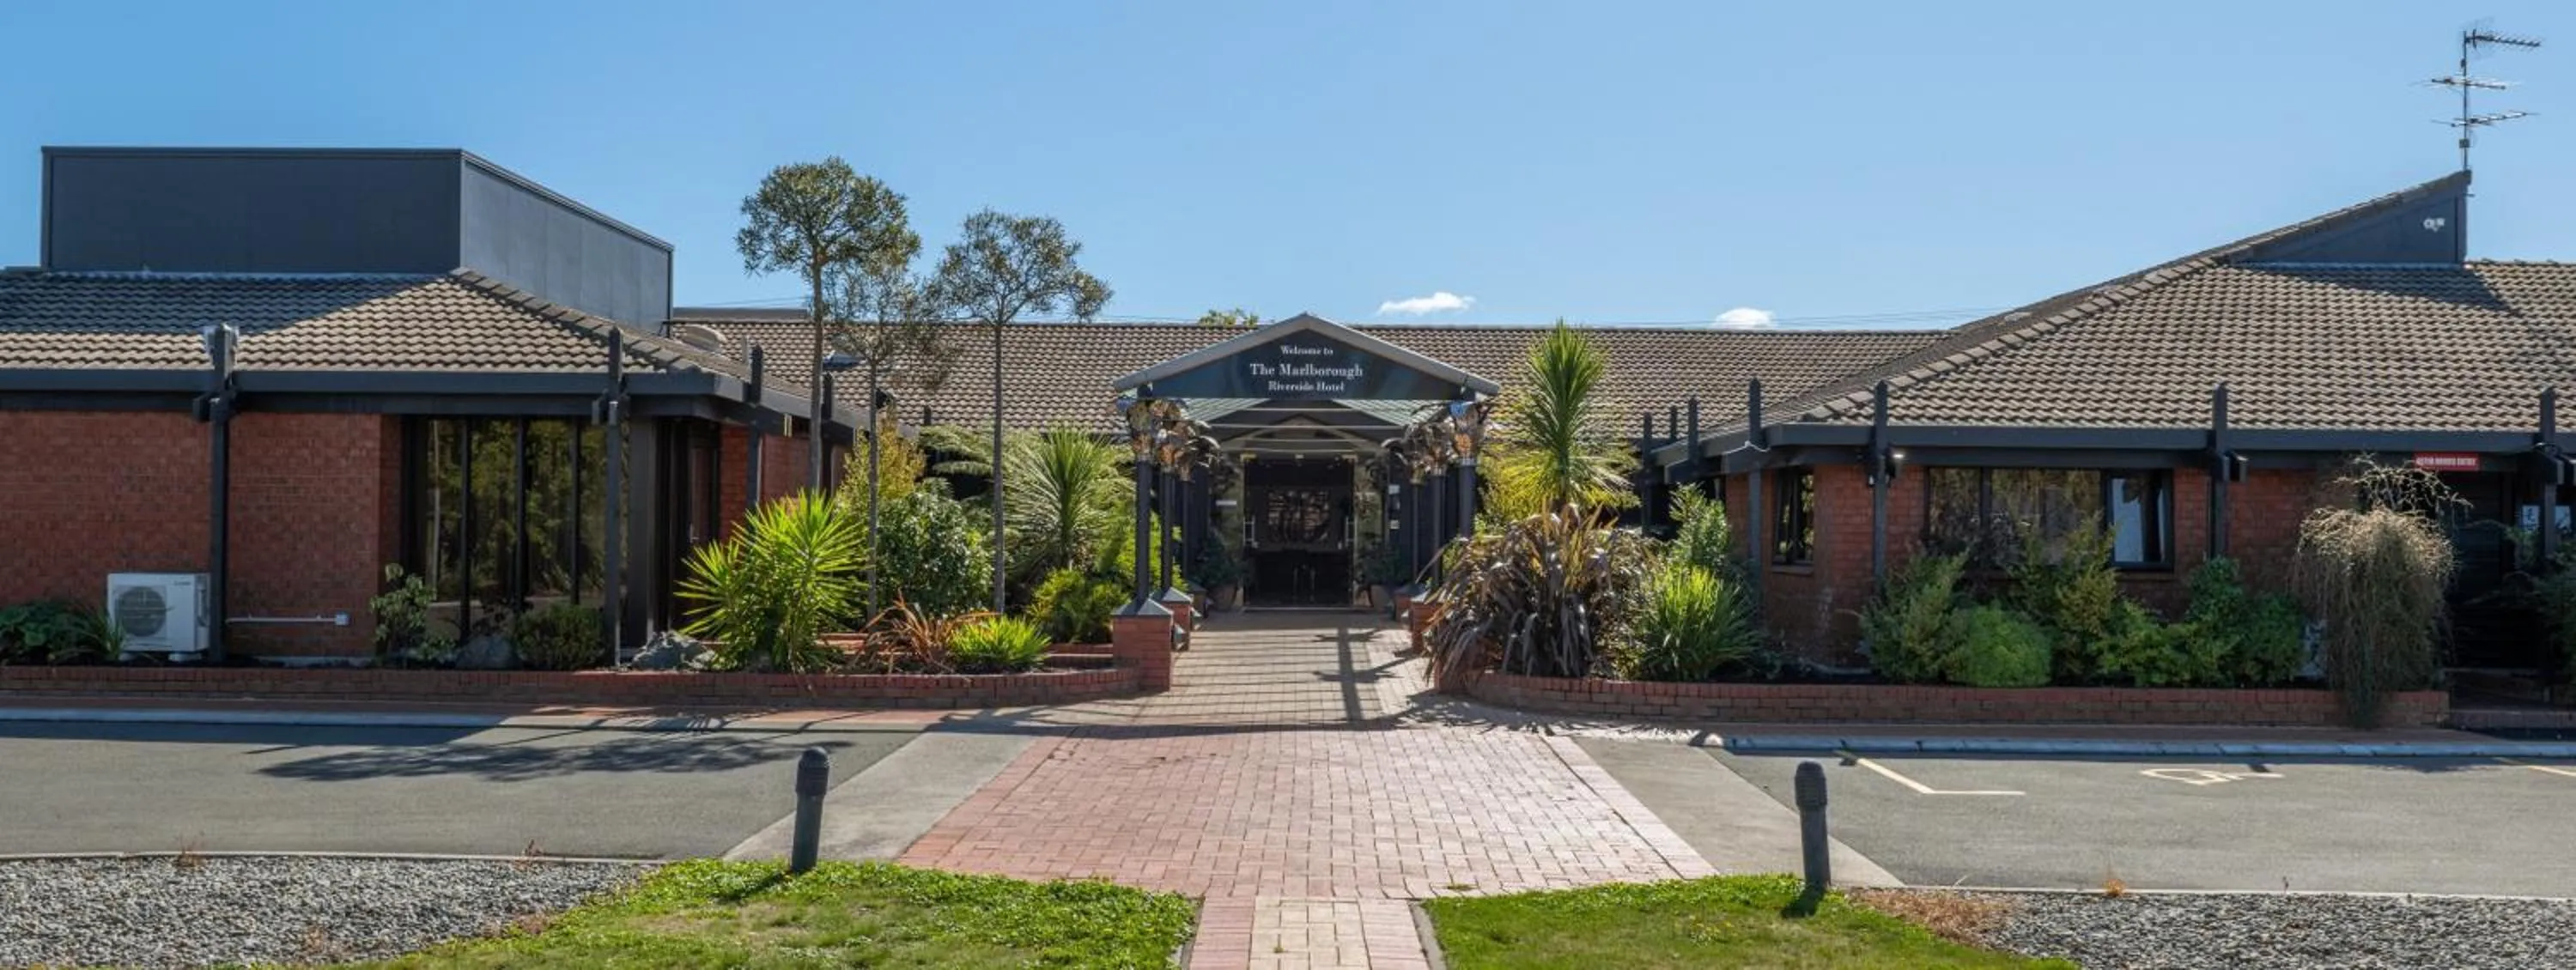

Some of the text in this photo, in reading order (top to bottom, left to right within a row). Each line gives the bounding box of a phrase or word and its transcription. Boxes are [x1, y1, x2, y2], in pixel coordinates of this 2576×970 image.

[1280, 345, 1334, 355] Welcome to
[1250, 363, 1363, 379] The Marlborough
[1268, 380, 1344, 391] Riverside Hotel
